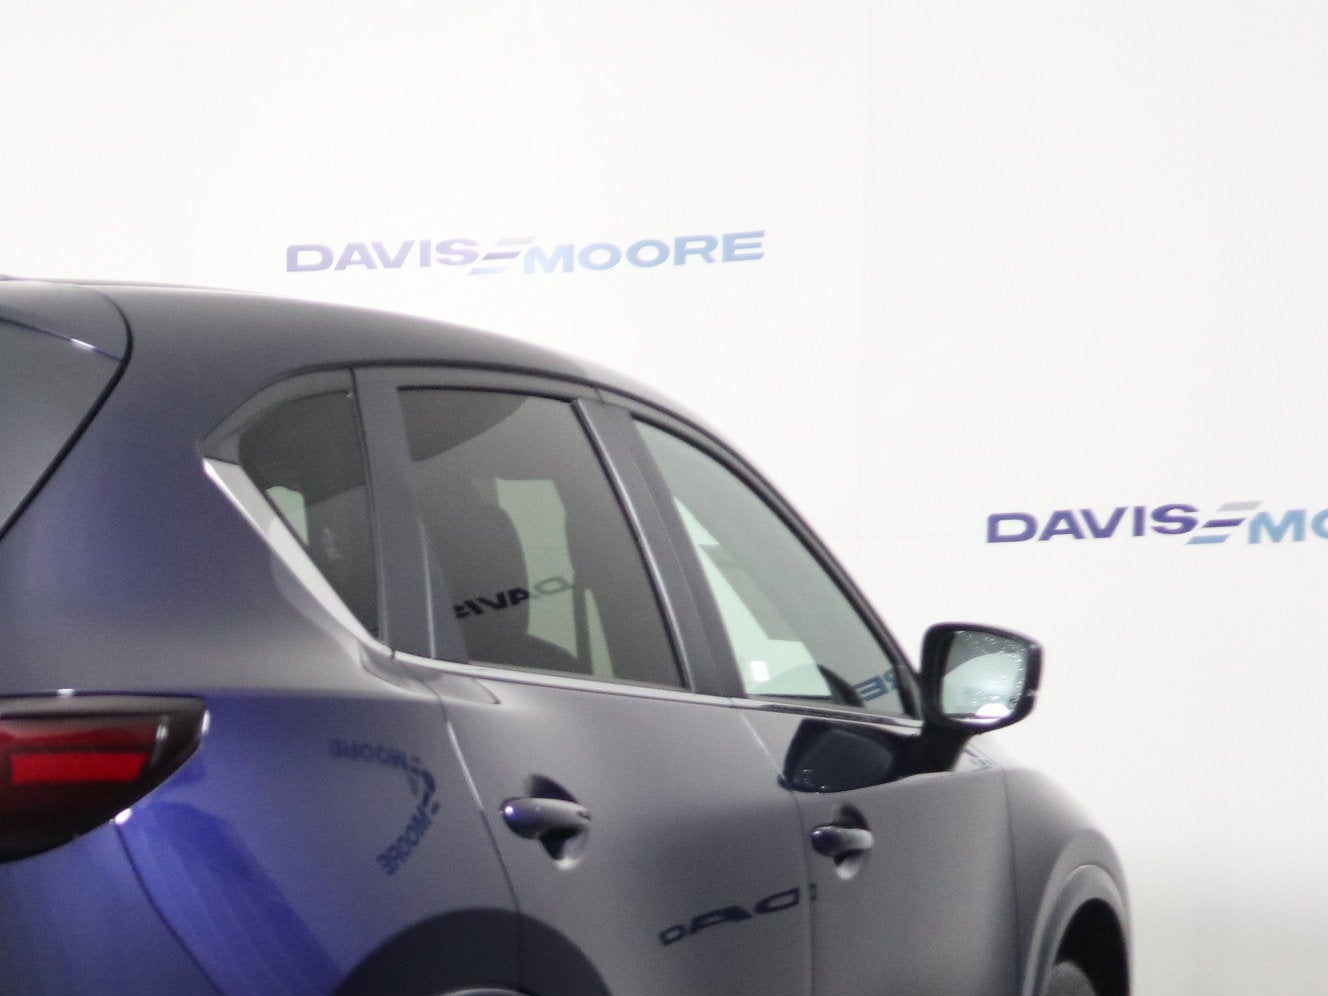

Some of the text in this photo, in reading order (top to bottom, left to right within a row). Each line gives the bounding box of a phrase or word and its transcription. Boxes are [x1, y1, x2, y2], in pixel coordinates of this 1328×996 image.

[285, 230, 766, 274] DAVIS MOORE
[985, 503, 1200, 543] DAVIS
